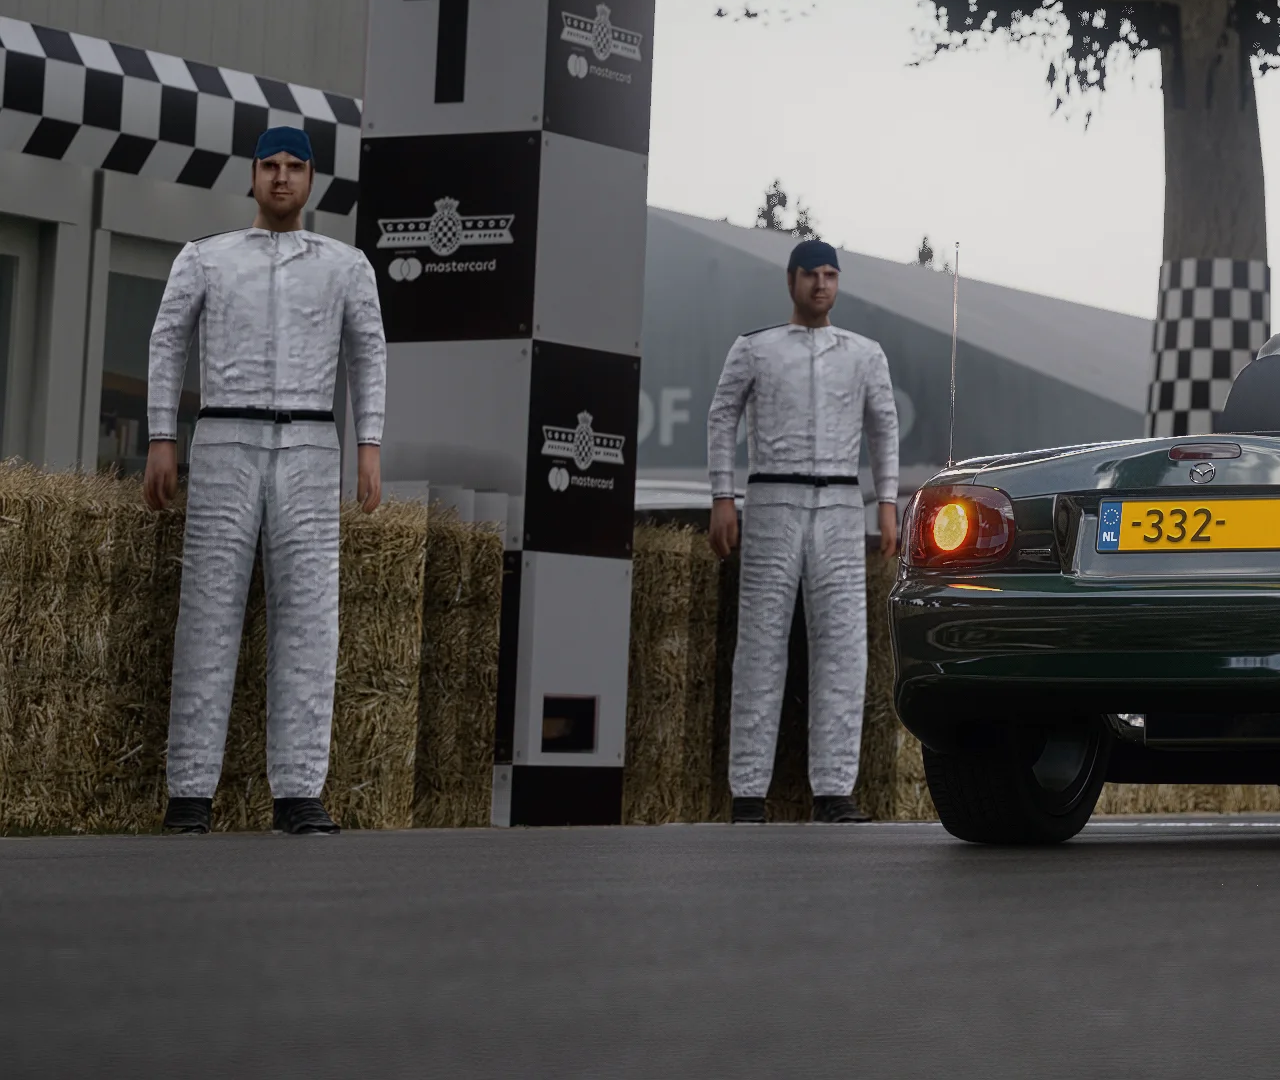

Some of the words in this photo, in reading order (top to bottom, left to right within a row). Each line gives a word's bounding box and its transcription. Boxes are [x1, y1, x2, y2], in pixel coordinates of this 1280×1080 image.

[589, 65, 632, 84] mastercard
[425, 258, 496, 273] mastercard
[571, 475, 614, 491] mastercard
[1131, 508, 1226, 542] -332-
[1103, 531, 1117, 542] NL
